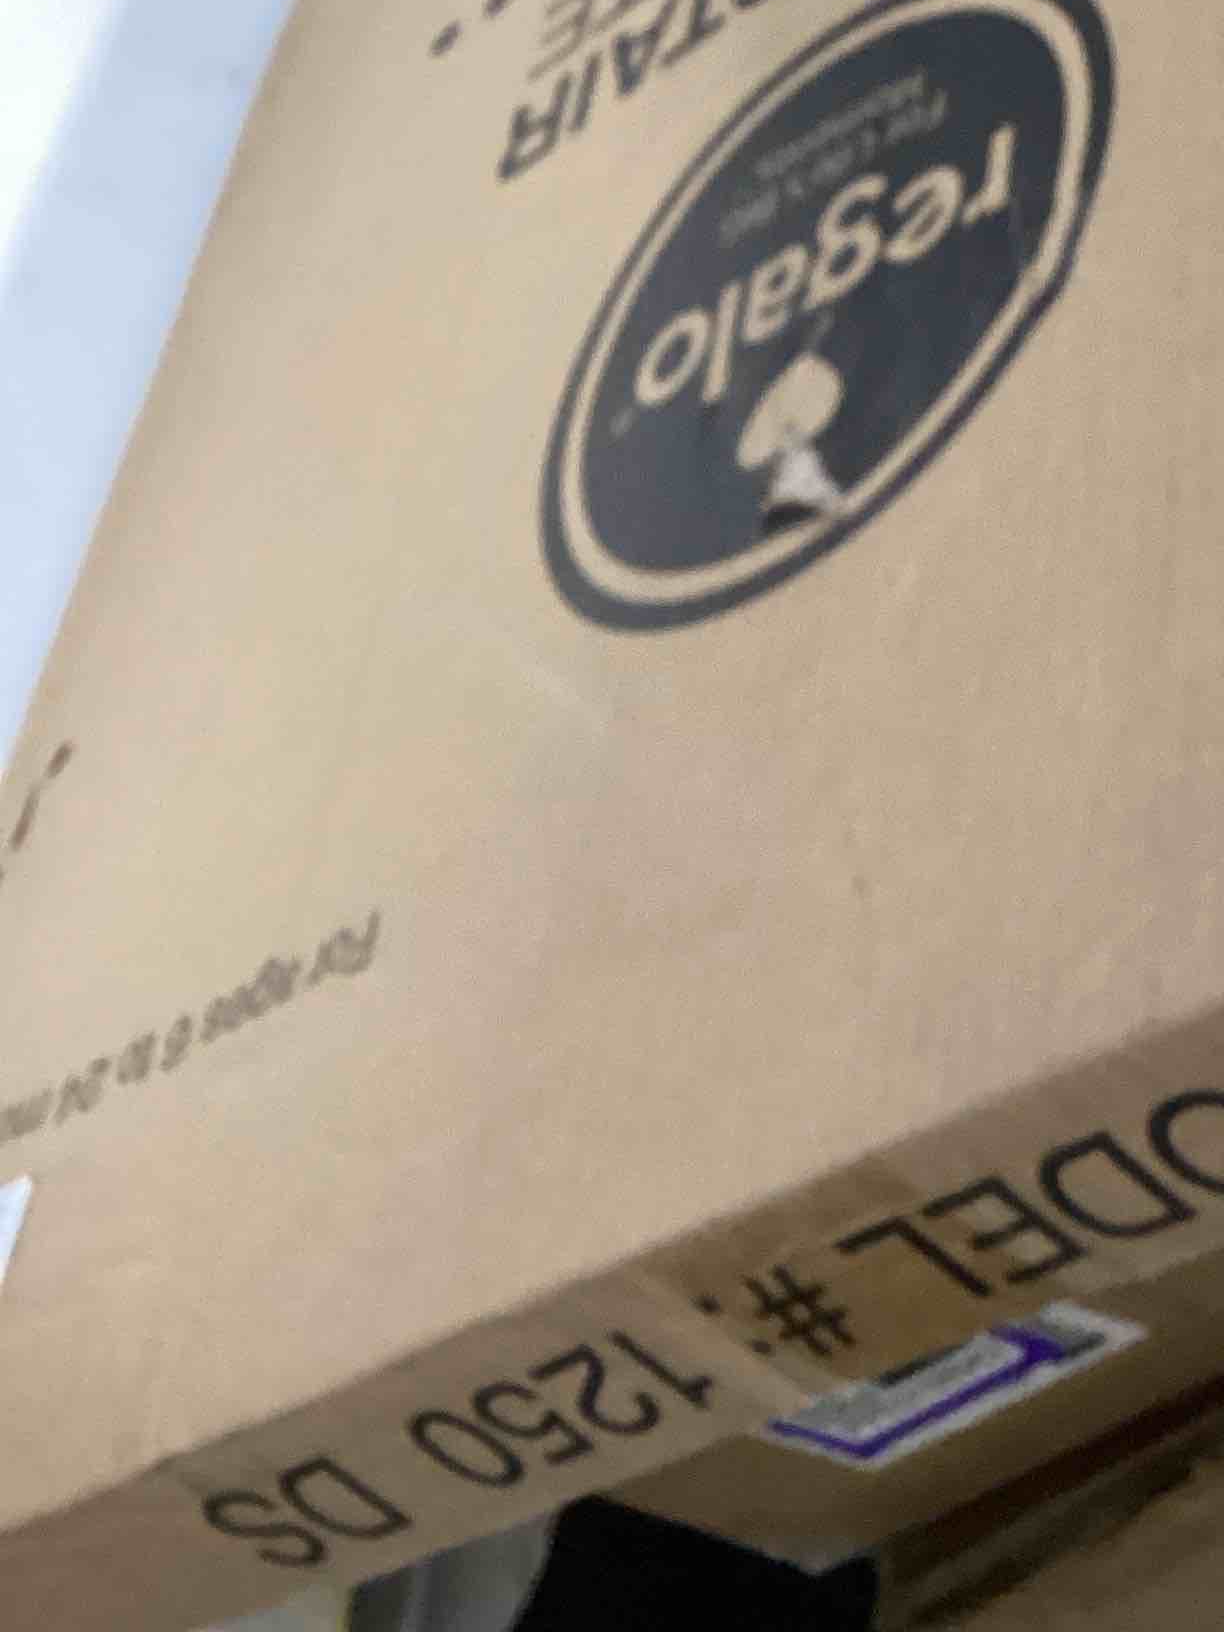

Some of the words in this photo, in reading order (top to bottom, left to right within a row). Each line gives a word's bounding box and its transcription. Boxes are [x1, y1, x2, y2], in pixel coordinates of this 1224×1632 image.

[632, 120, 1018, 408] regalo
[307, 908, 382, 988] For
[405, 1329, 716, 1493] 1250
[201, 1454, 414, 1569] DS
